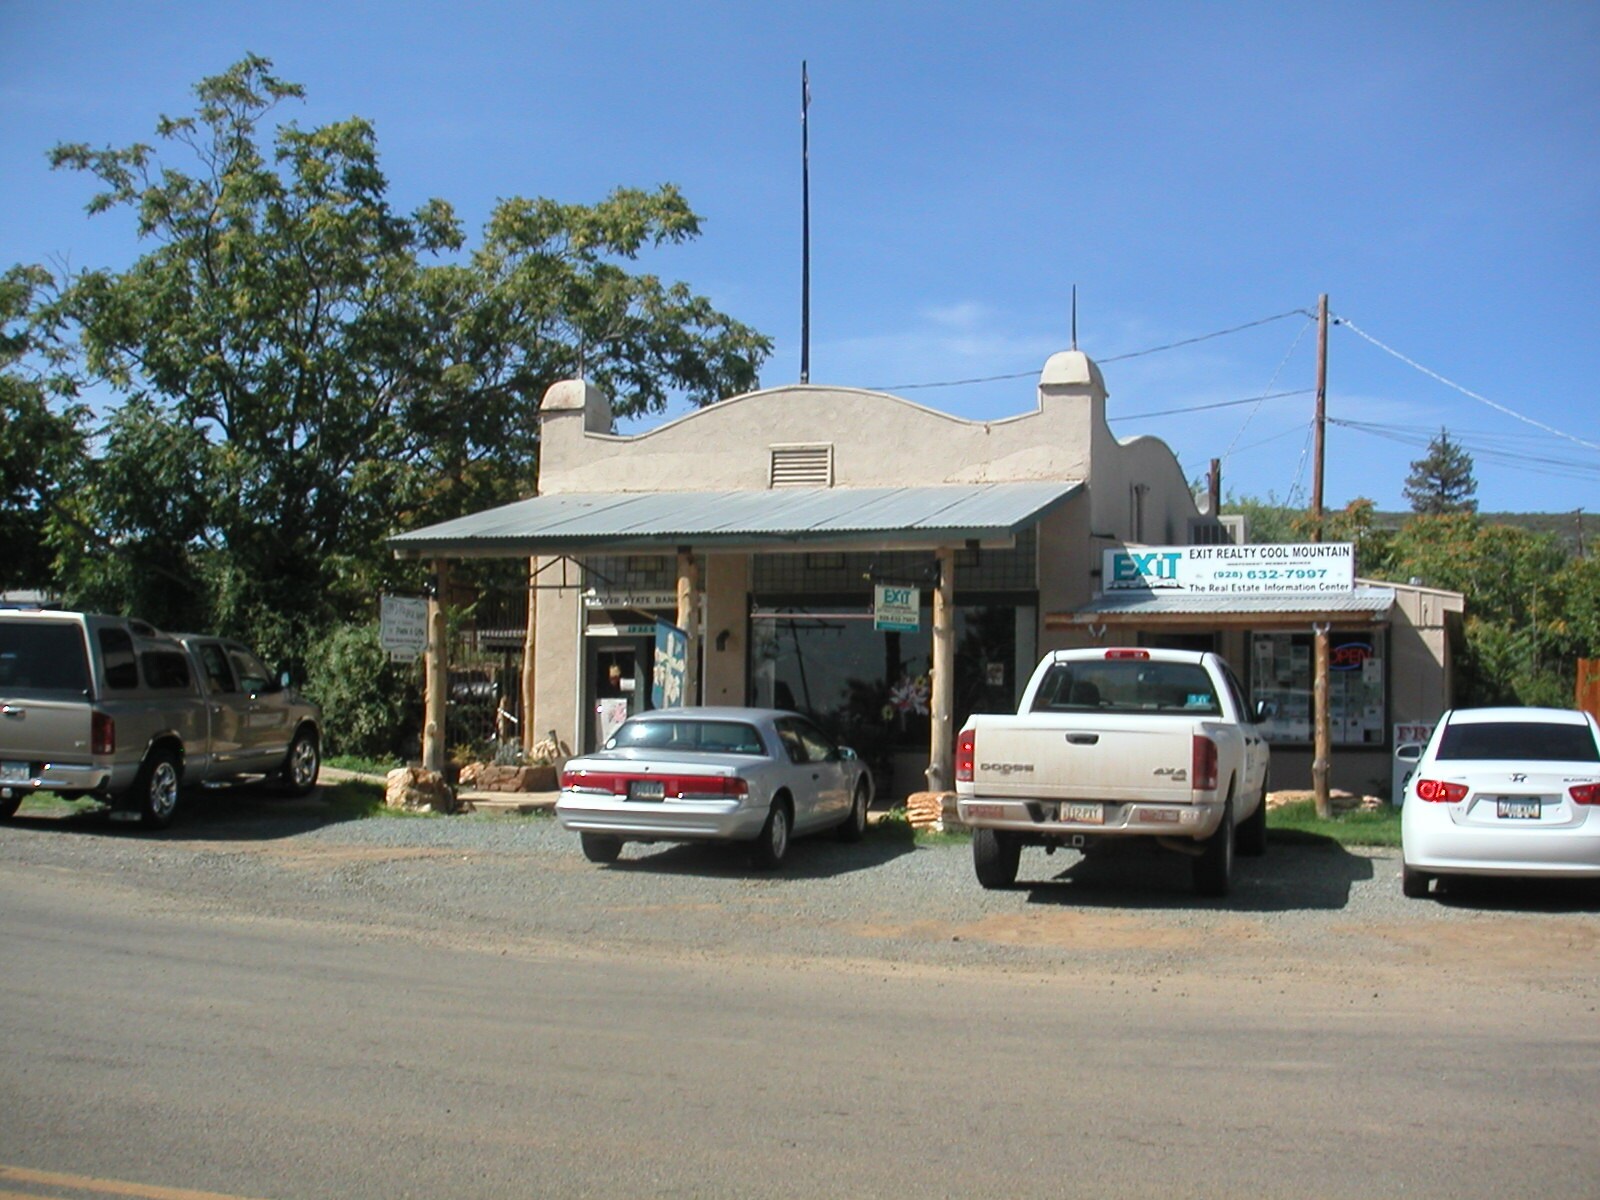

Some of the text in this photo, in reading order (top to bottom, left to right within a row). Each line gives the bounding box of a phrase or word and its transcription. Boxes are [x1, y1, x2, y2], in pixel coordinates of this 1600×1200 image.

[1189, 546, 1350, 560] EXIT REALTY COOL MOUNTAIN
[1213, 568, 1328, 580] (928) 632-7997
[1189, 582, 1350, 593] The Real Estate Information Center
[655, 596, 678, 604] BAN
[1397, 726, 1434, 742] FR
[980, 763, 1034, 772] DODGE
